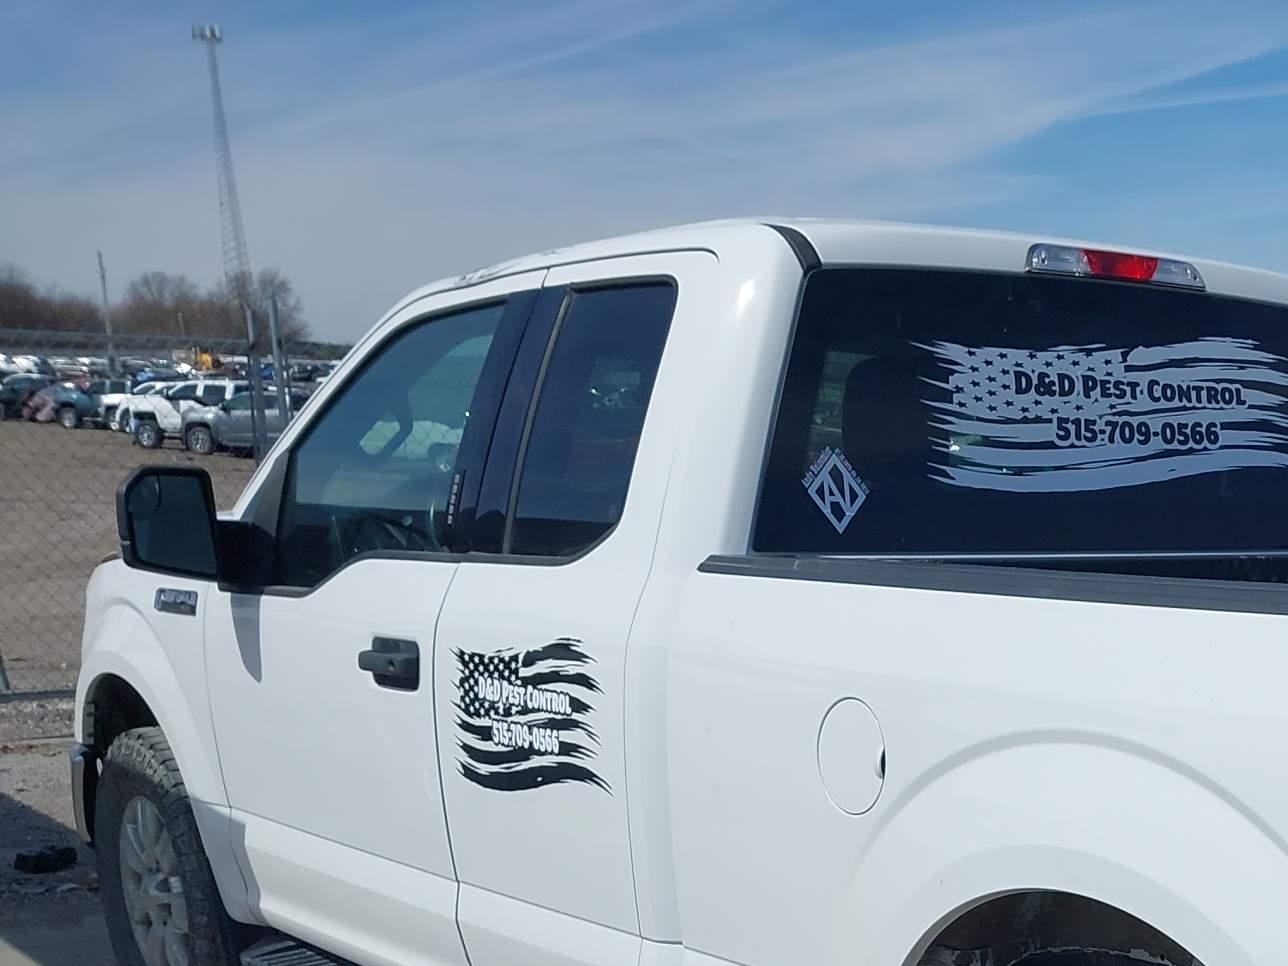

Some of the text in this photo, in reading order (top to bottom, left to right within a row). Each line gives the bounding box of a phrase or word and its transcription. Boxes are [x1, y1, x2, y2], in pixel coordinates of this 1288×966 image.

[1013, 371, 1247, 406] D&D PEST CONTROL
[1055, 416, 1220, 446] 515-709-0566
[478, 675, 572, 715] D&D PEST CONTROL
[492, 719, 560, 754] 515-709-0566
